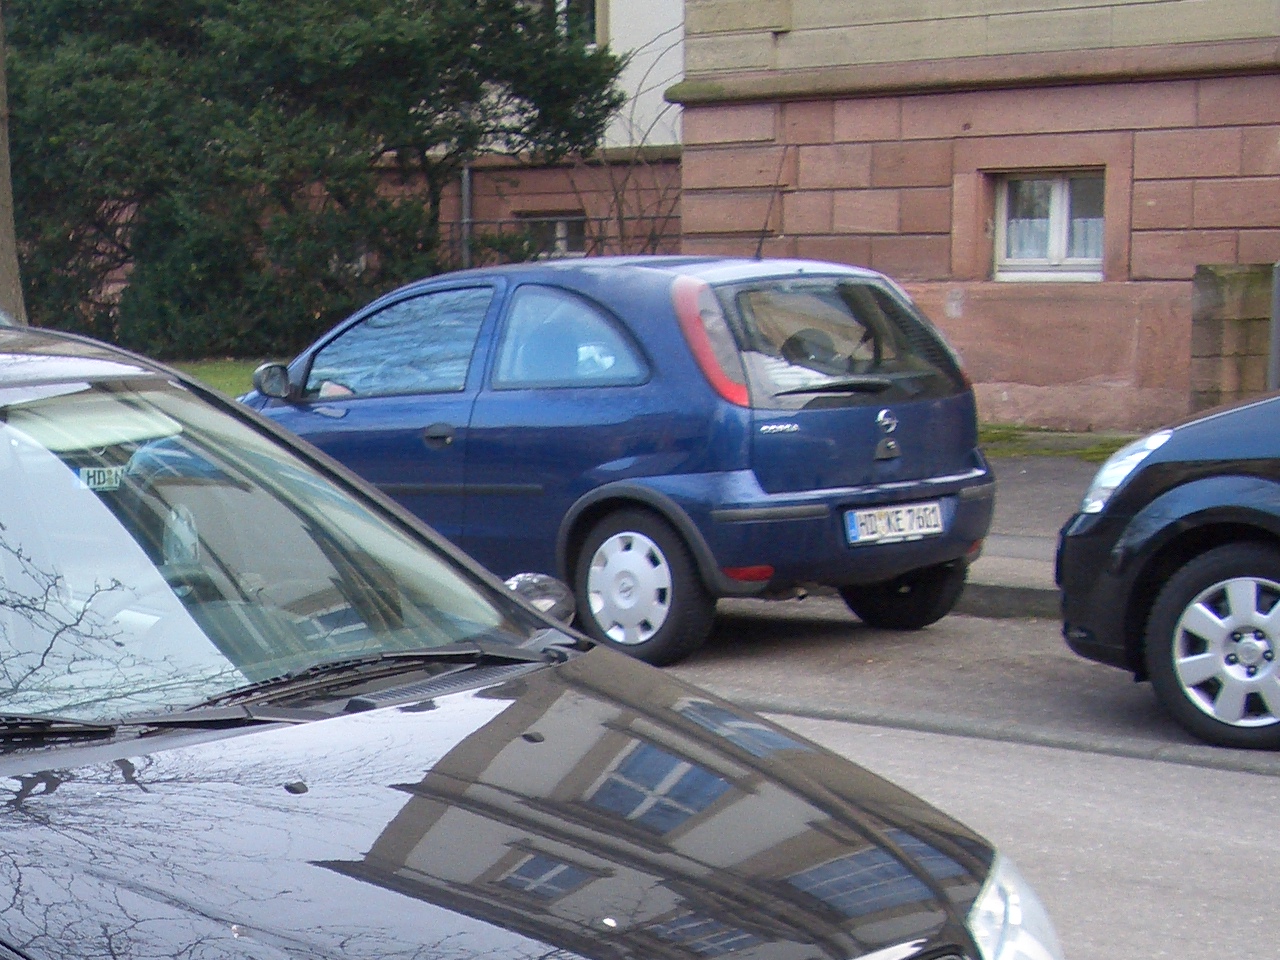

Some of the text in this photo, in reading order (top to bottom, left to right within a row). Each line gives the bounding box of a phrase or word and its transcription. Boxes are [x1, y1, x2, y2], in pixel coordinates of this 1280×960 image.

[86, 469, 106, 486] HD
[858, 513, 877, 536] HD
[886, 510, 904, 532] KE
